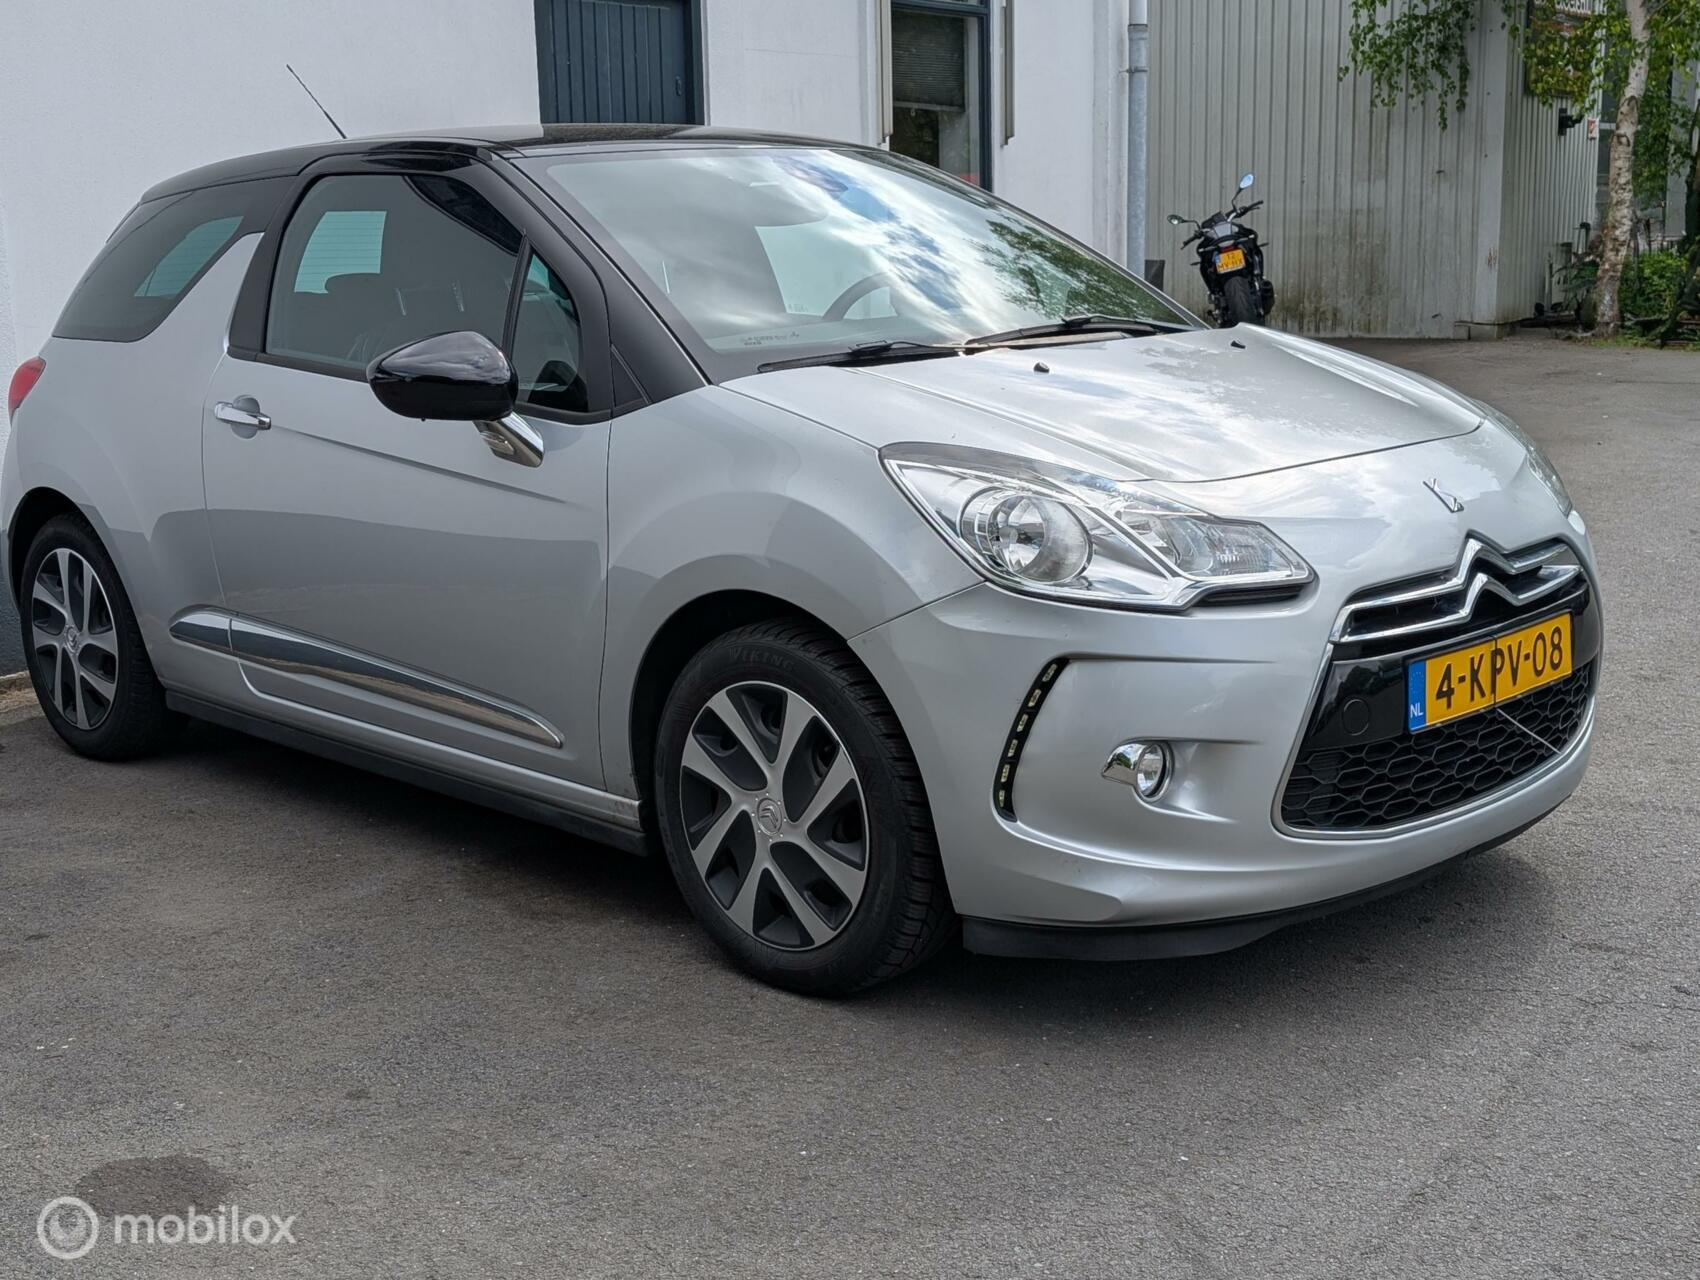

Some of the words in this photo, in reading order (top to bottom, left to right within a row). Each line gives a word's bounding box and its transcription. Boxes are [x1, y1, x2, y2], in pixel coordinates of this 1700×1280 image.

[729, 646, 795, 672] VIKING
[1435, 626, 1563, 710] 4-KPV-08
[1410, 702, 1424, 719] NL
